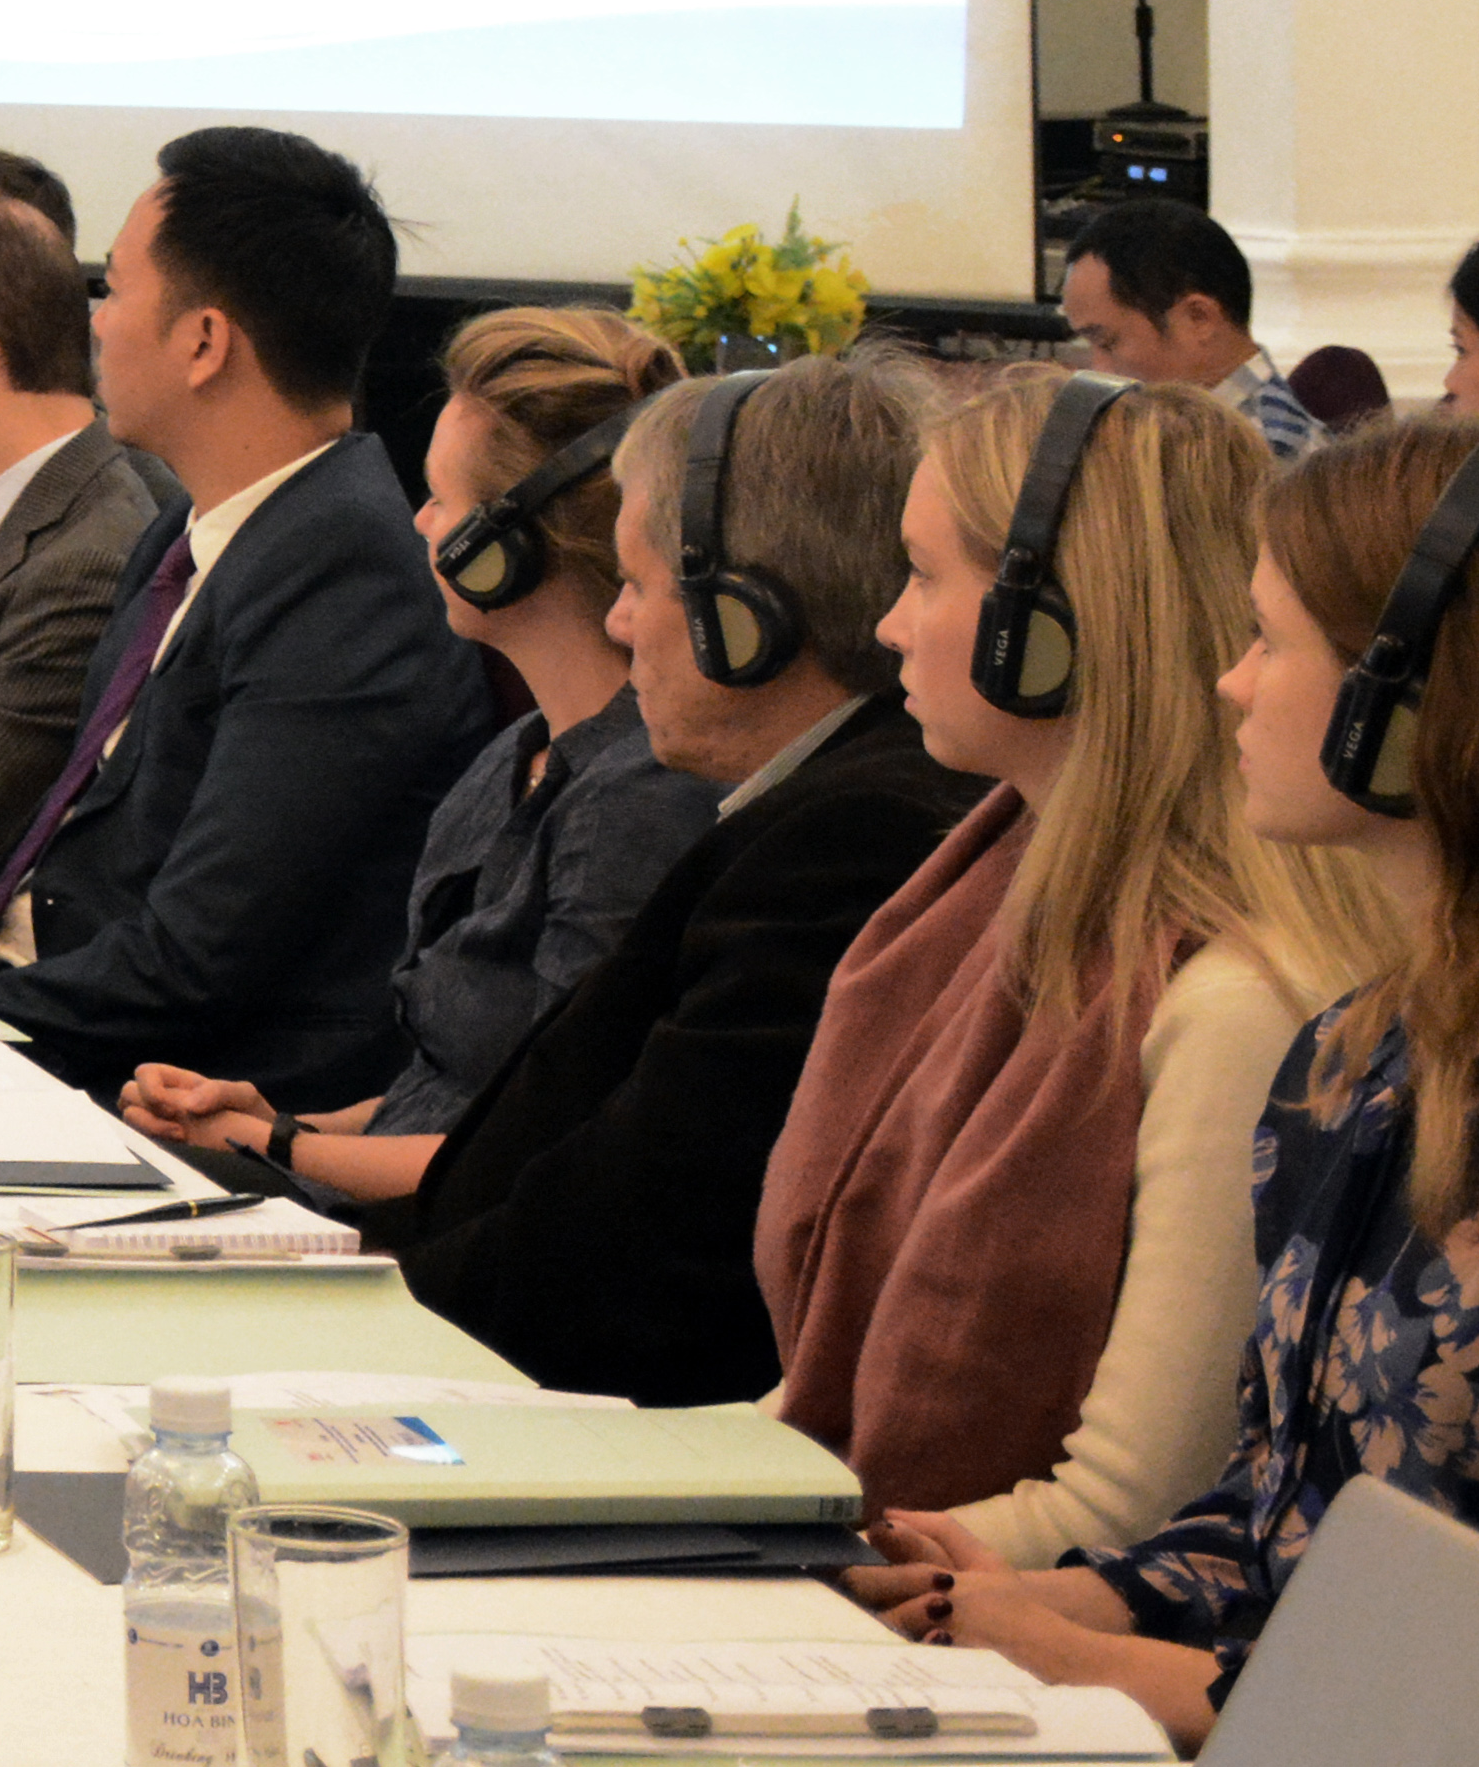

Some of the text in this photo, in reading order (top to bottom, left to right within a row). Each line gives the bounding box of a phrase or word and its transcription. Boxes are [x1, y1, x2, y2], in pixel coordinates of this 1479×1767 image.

[992, 630, 1010, 666] VEGA
[1342, 721, 1364, 759] VEGA
[187, 1670, 229, 1705] HB
[163, 1711, 204, 1729] HOA
